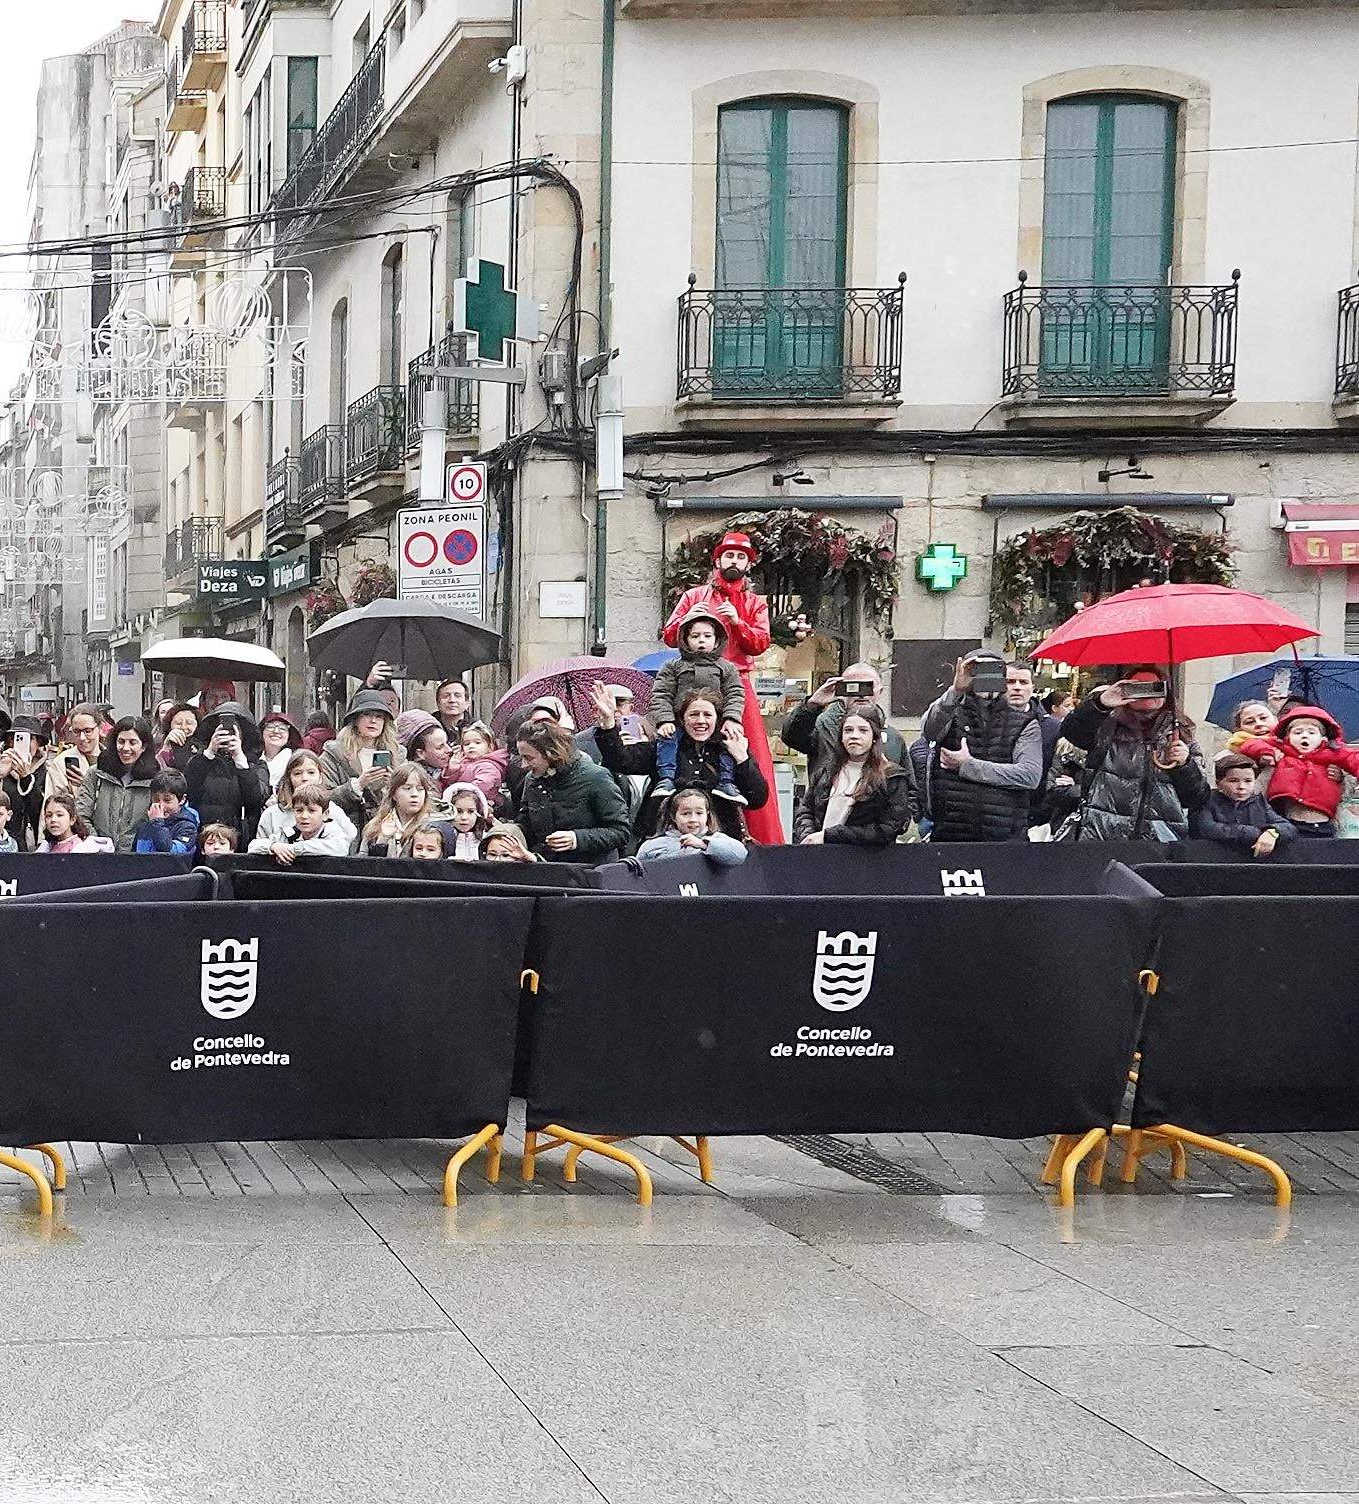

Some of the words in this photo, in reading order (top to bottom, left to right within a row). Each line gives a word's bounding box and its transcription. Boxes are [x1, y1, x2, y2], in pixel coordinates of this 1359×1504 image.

[458, 477, 474, 490] 10
[403, 513, 434, 526] ZONA
[437, 511, 479, 524] PEONIL
[200, 566, 238, 579] Viajes
[200, 579, 238, 592] Deza
[796, 1026, 873, 1042] Concello
[193, 1033, 265, 1052] Concello
[770, 1042, 794, 1058] de
[796, 1042, 895, 1058] Pontevedra
[170, 1055, 193, 1072] de
[194, 1049, 291, 1069] Pontevedra
